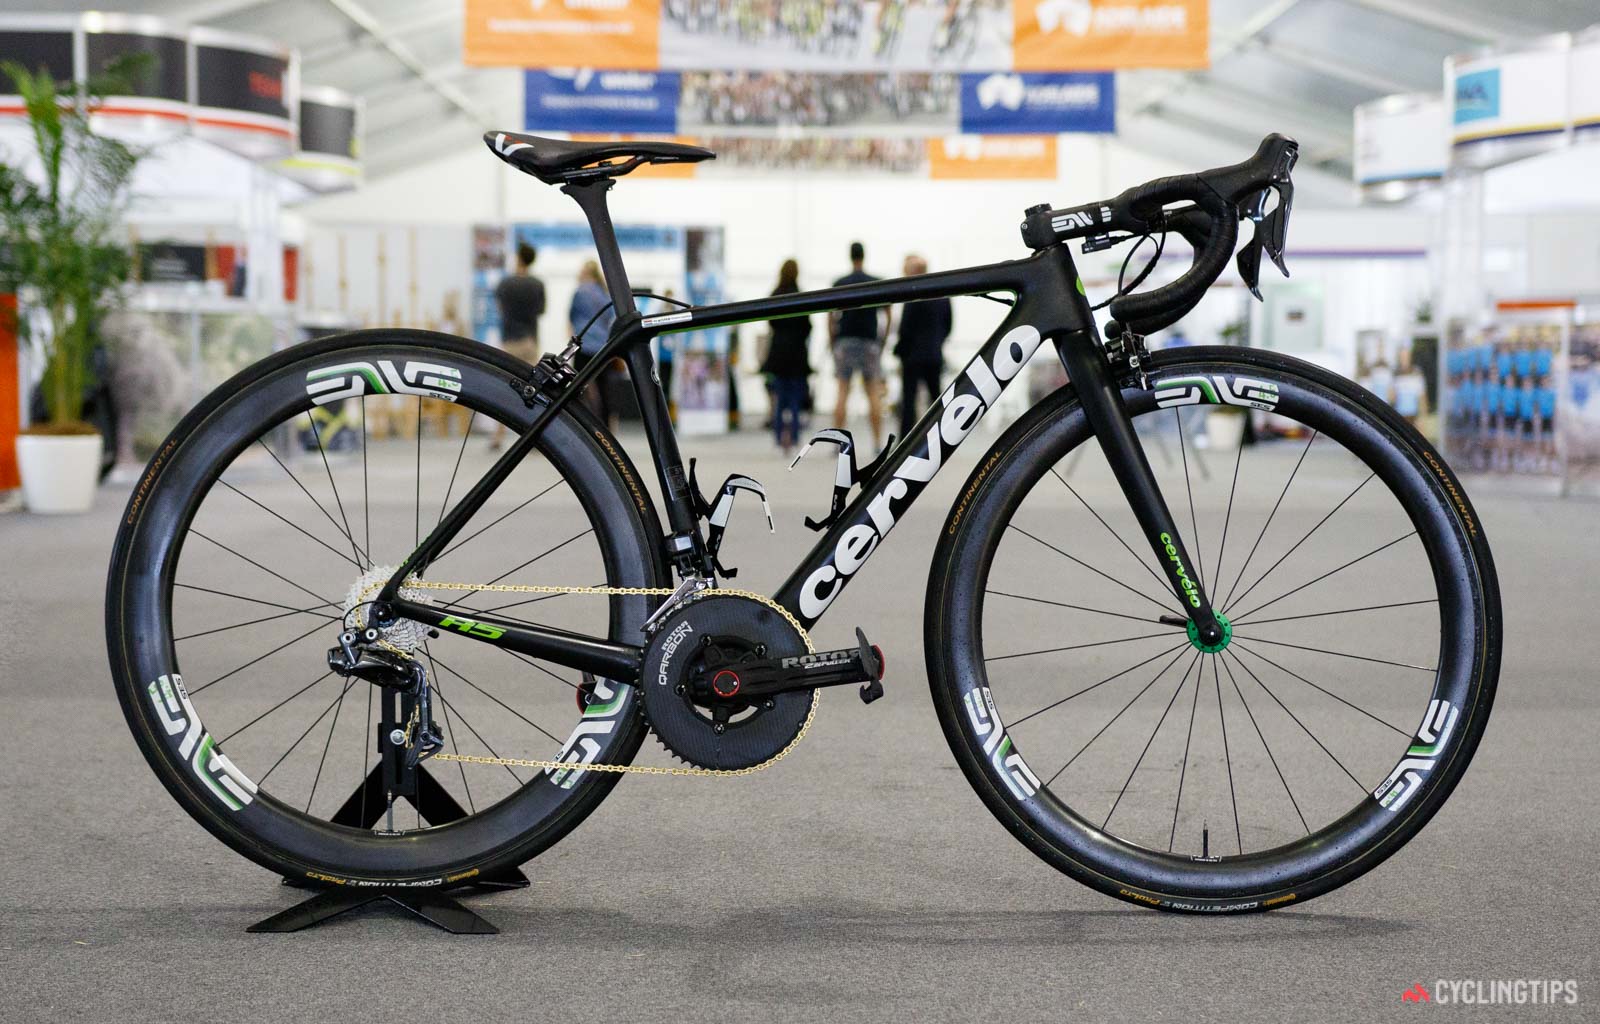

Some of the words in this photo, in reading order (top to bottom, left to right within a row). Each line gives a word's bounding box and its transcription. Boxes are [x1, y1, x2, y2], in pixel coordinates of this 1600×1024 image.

[305, 360, 462, 406] ENVE
[1154, 376, 1280, 412] ENVE
[128, 439, 177, 524] CONTINENTAL
[595, 431, 646, 513] CONTINENTAL
[799, 325, 1041, 619] cervélo
[949, 451, 1002, 535] CONTINENTAL
[1423, 451, 1477, 537] CONTINENTAL
[1160, 532, 1201, 608] cervélo
[438, 614, 507, 639] R5
[661, 620, 689, 651] ROTOR
[148, 673, 259, 811] ENVE
[964, 686, 1041, 800] ENVE
[1374, 699, 1459, 812] ENVE
[1172, 902, 1258, 912] COMPETITION
